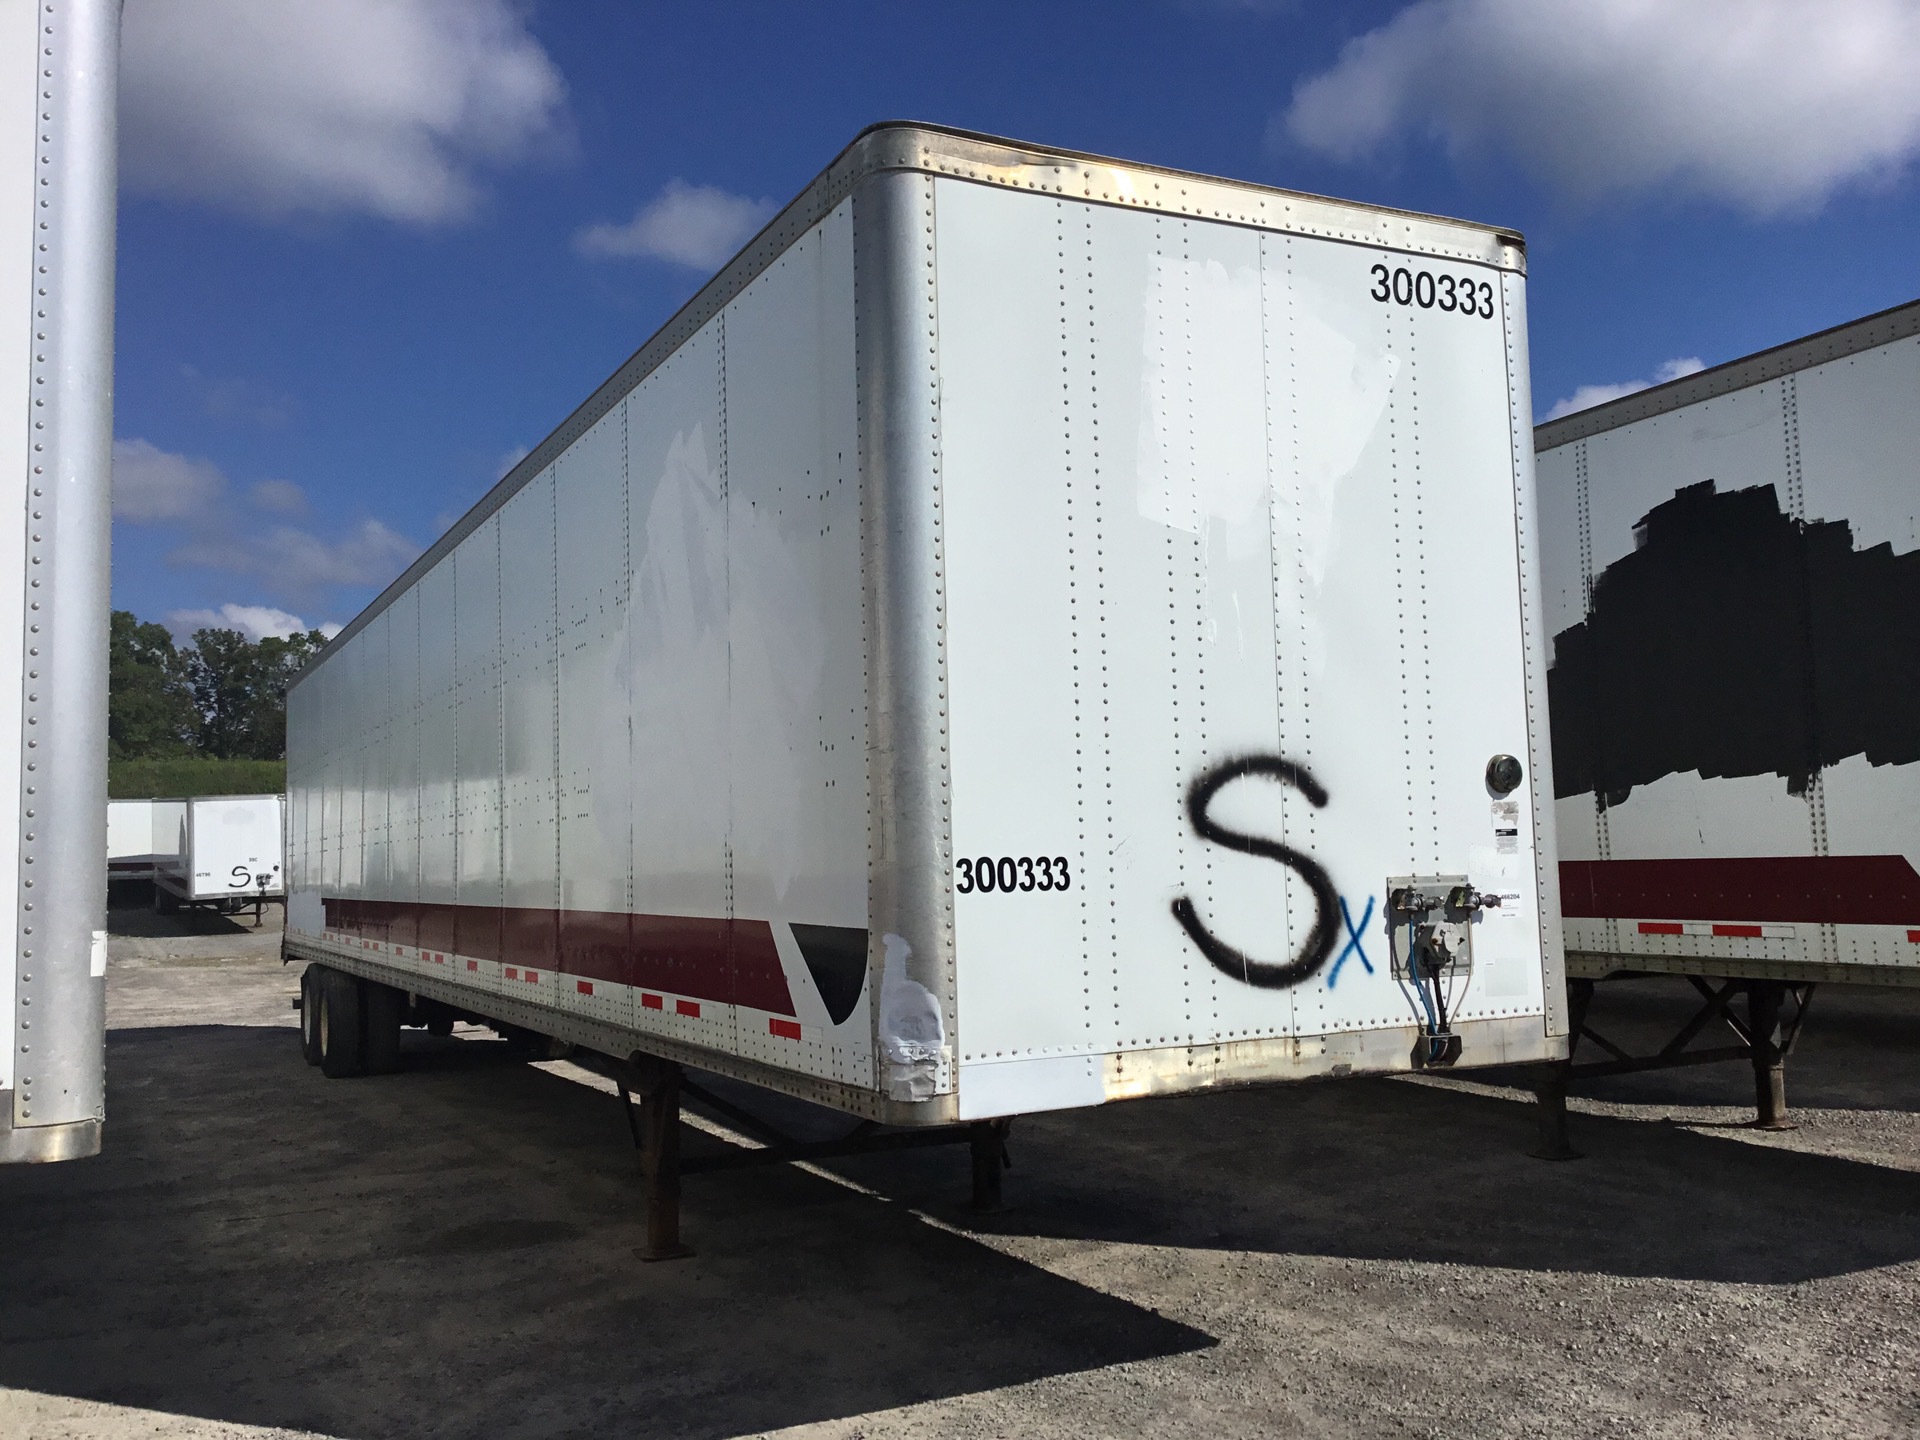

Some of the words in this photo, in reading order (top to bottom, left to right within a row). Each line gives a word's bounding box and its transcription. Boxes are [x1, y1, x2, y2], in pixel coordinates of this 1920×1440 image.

[1371, 264, 1494, 320] 300333
[228, 866, 251, 888] S
[955, 856, 1071, 894] 300333
[1171, 753, 1340, 990] S
